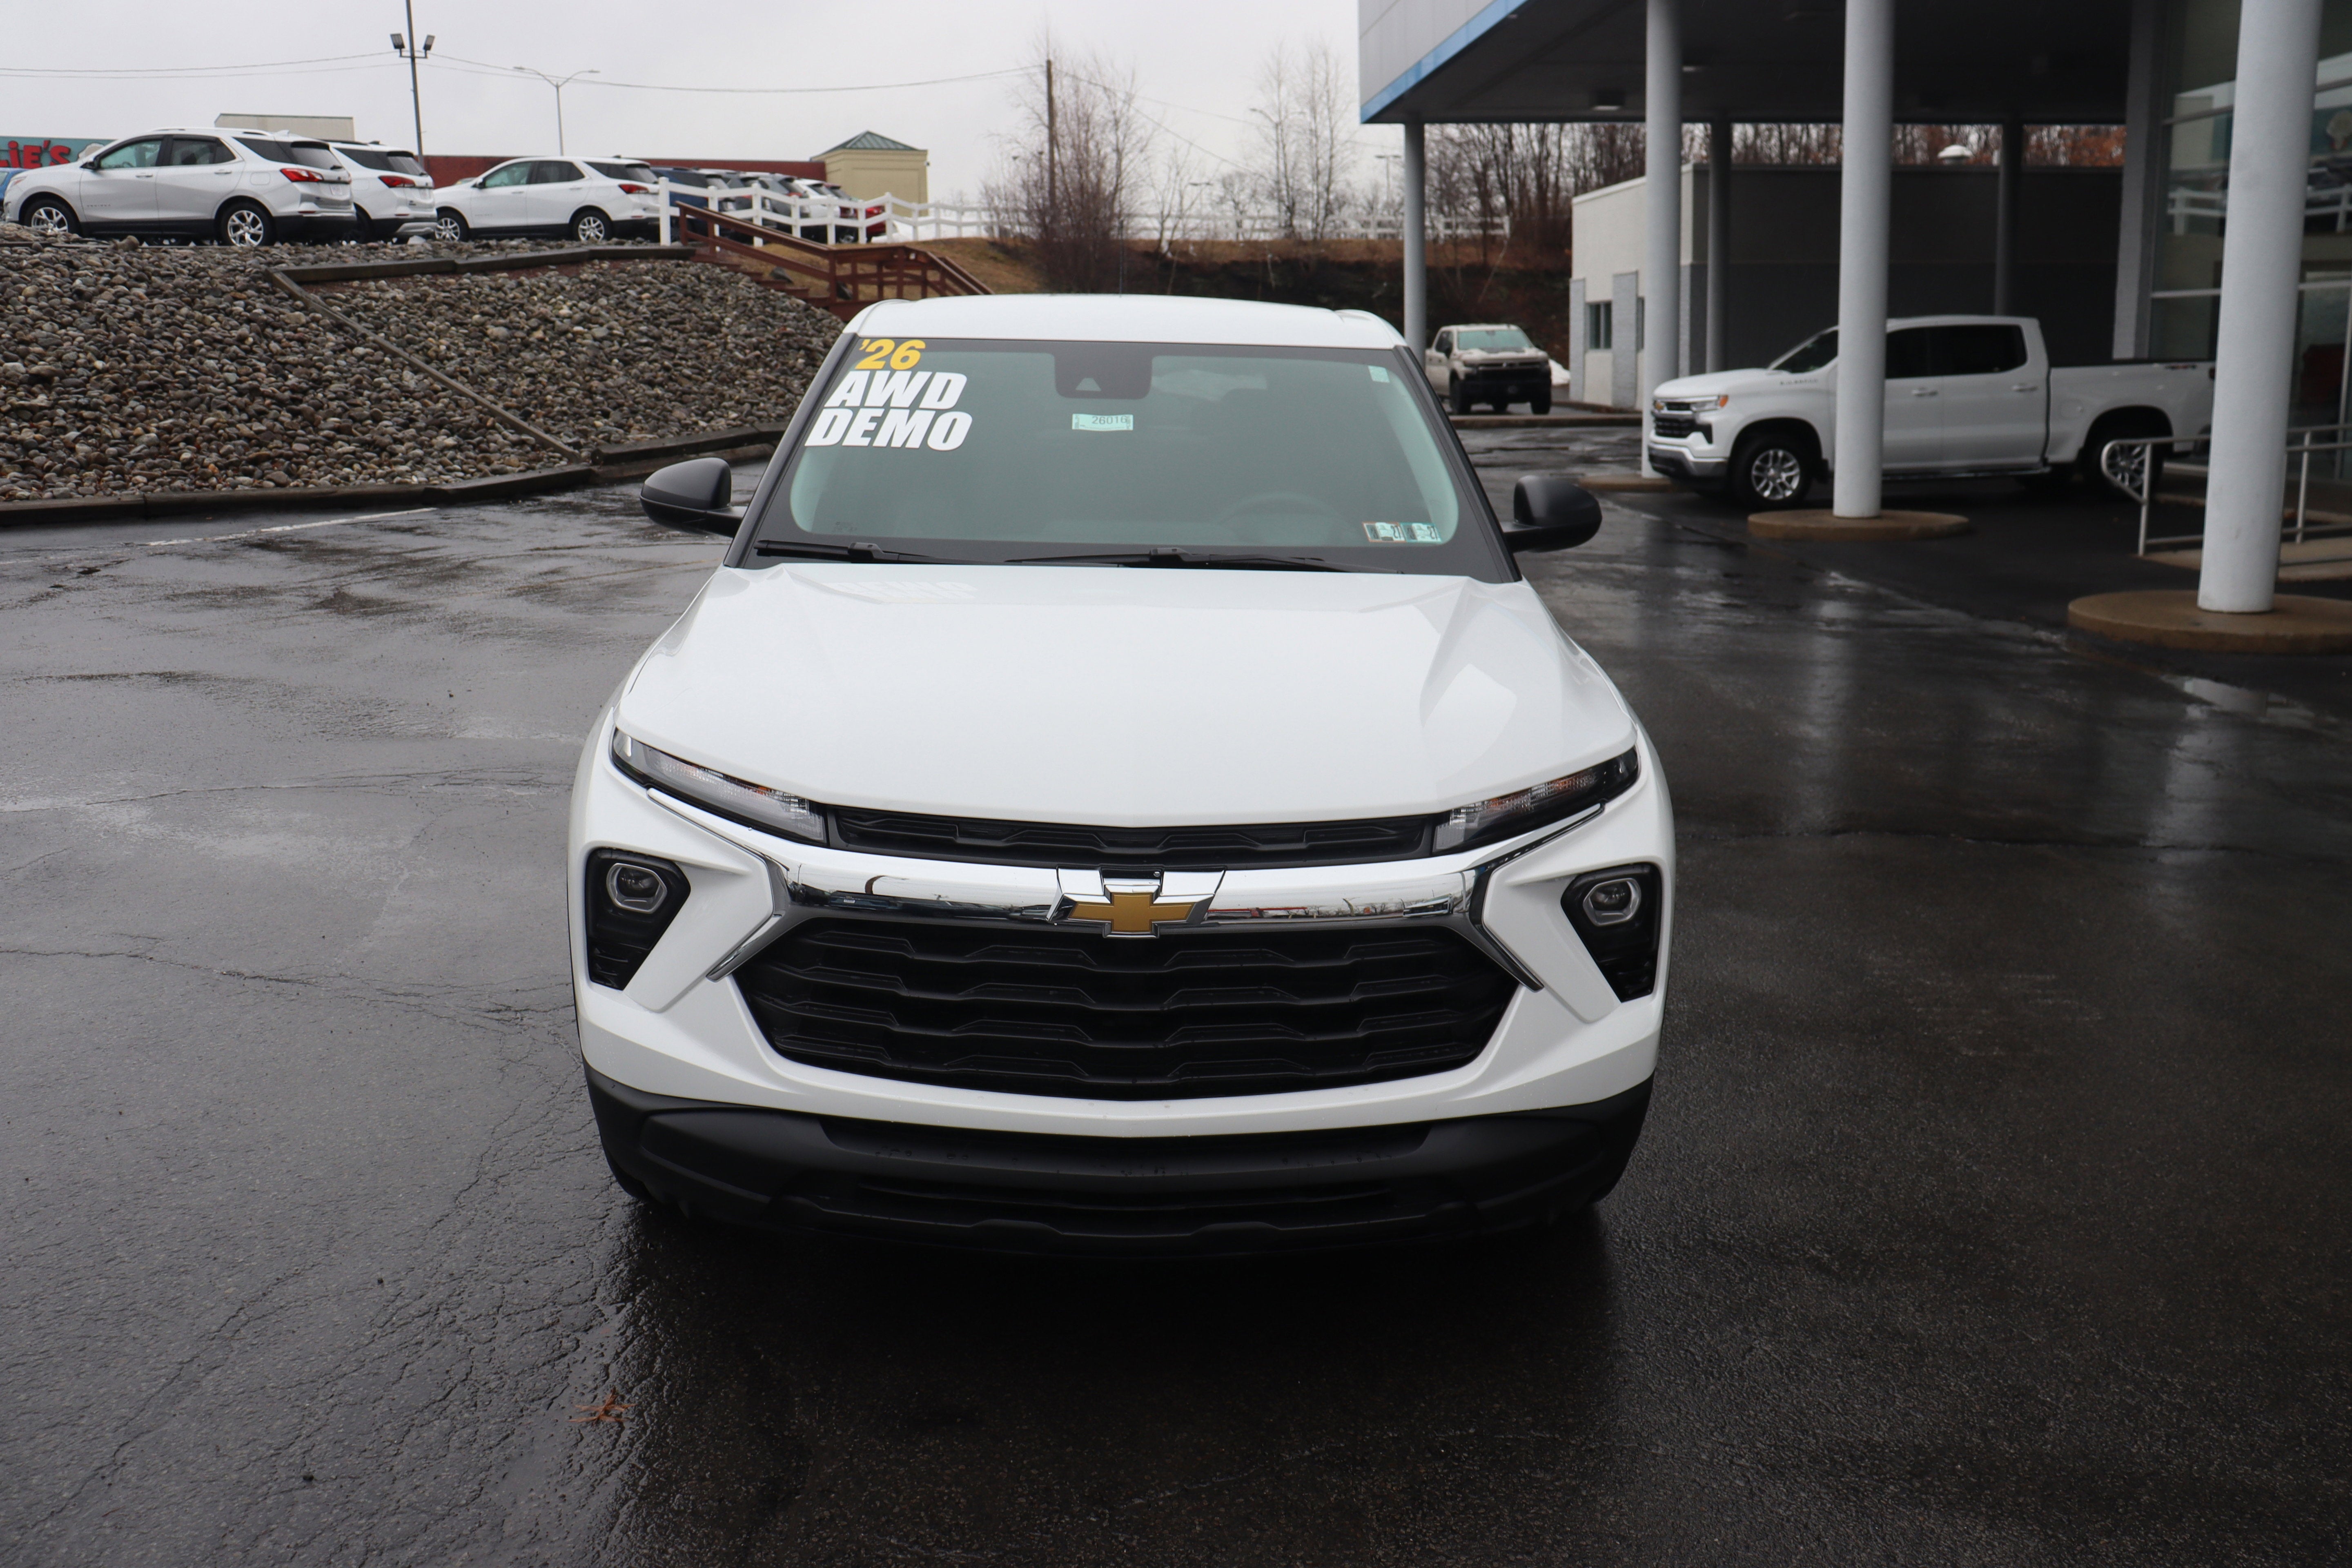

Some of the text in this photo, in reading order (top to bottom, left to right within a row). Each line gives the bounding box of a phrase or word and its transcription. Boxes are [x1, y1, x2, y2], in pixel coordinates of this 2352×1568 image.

[855, 339, 926, 370] '26
[824, 370, 967, 409] AWD
[804, 408, 973, 451] DEMO
[1092, 415, 1127, 425] 26016
